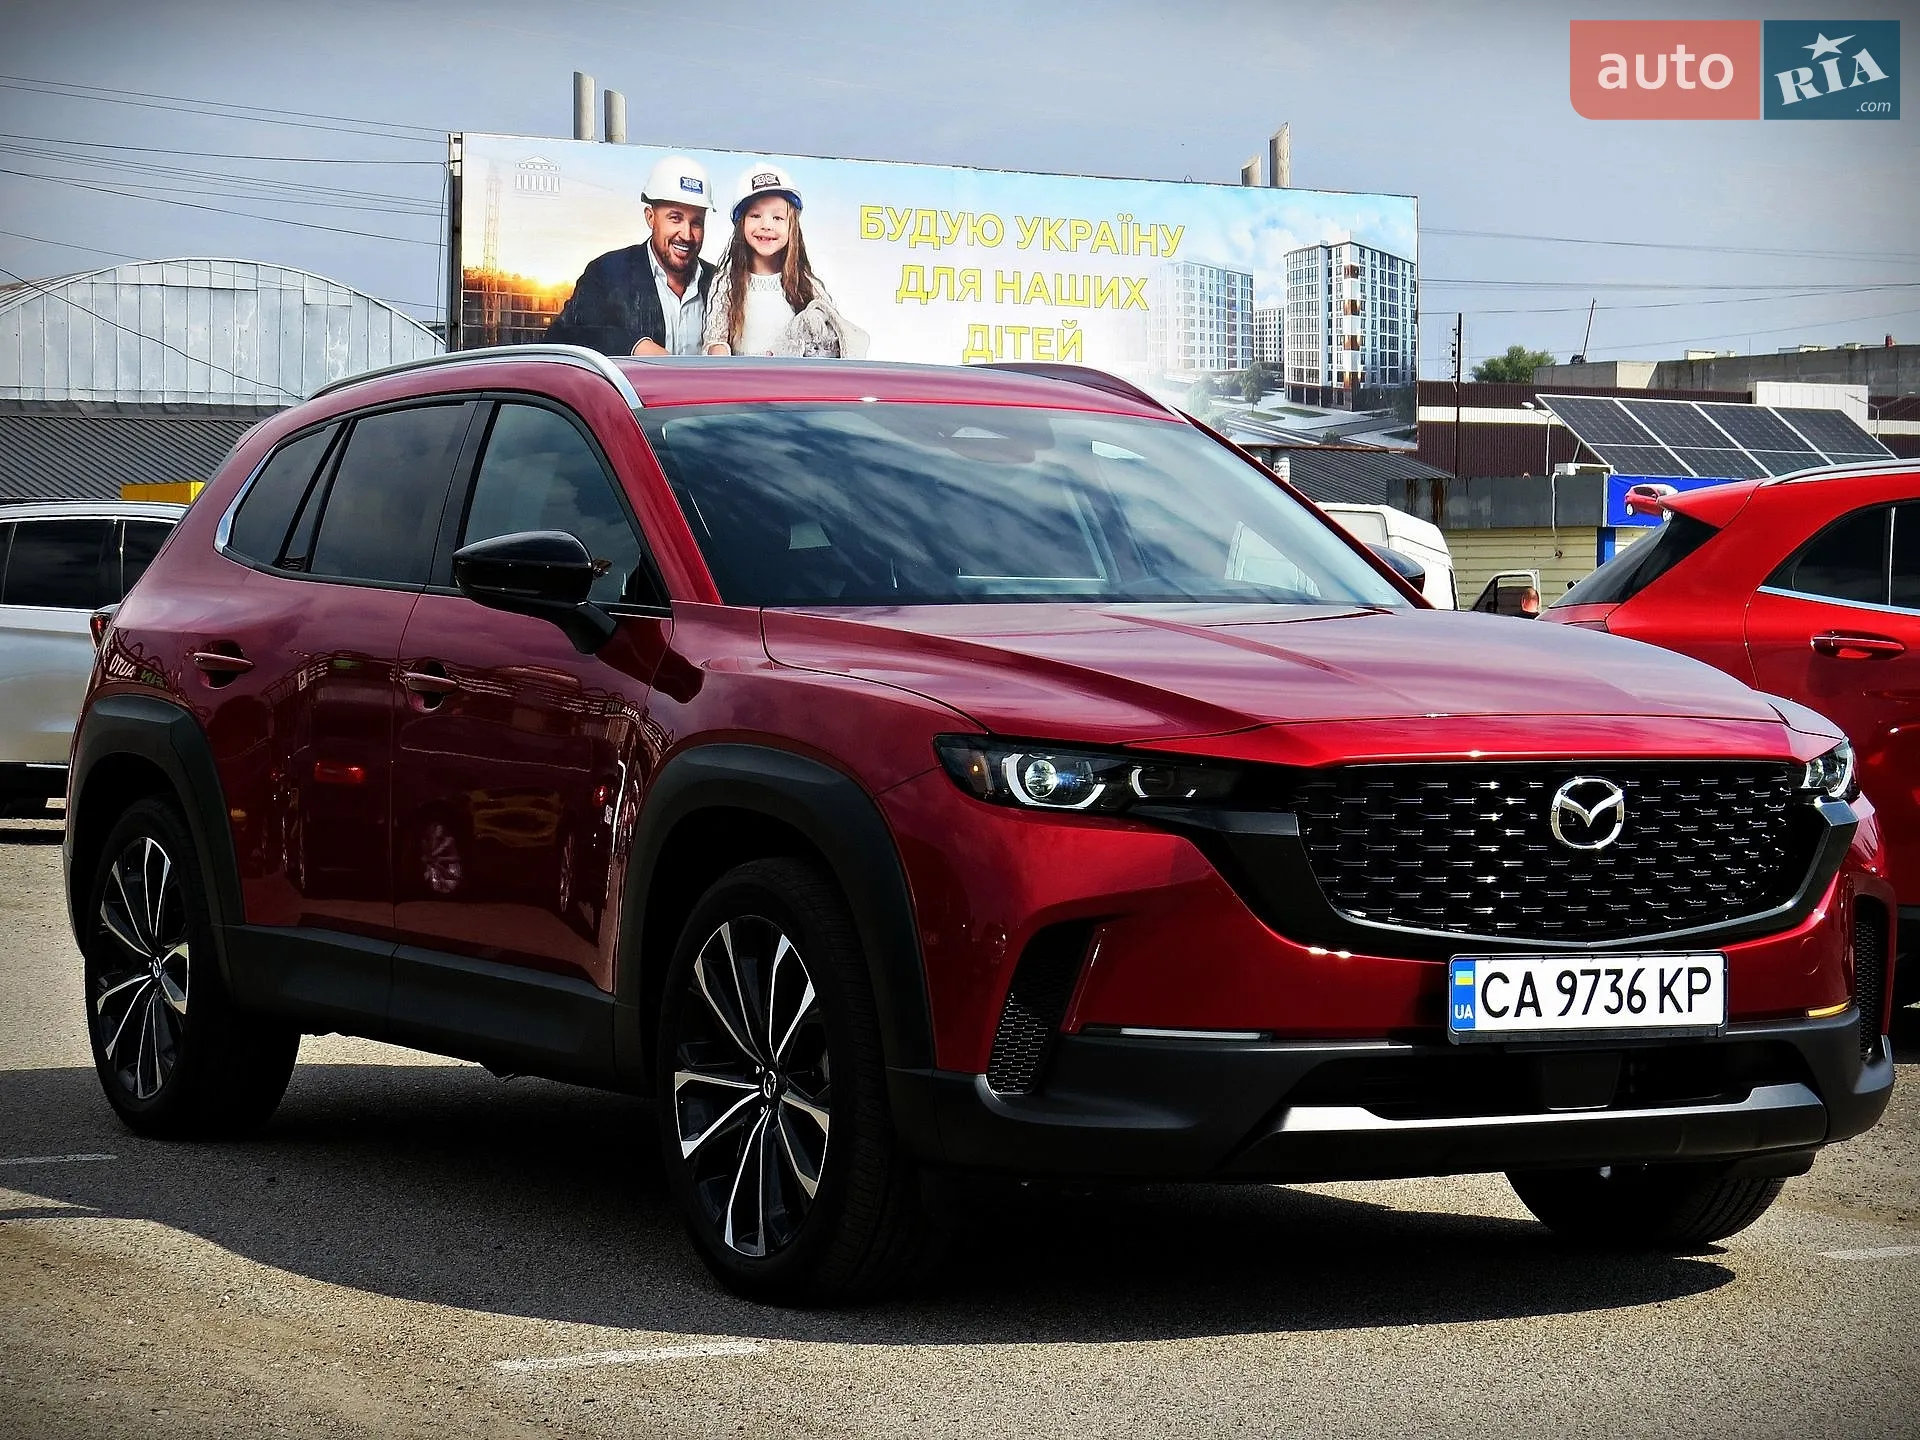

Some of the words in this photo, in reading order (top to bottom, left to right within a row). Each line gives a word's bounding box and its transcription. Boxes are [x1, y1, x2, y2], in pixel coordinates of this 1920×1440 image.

[860, 205, 1005, 250] БУДУЮ
[1015, 213, 1186, 258] УКРАЇНУ
[896, 264, 982, 305] ДЛЯ
[995, 270, 1150, 311] НАШИХ
[962, 319, 1084, 363] ДІТЕЙ
[1454, 1004, 1474, 1020] UA
[1481, 971, 1543, 1018] CA
[1556, 967, 1647, 1017] 9736
[1659, 966, 1712, 1014] KP
